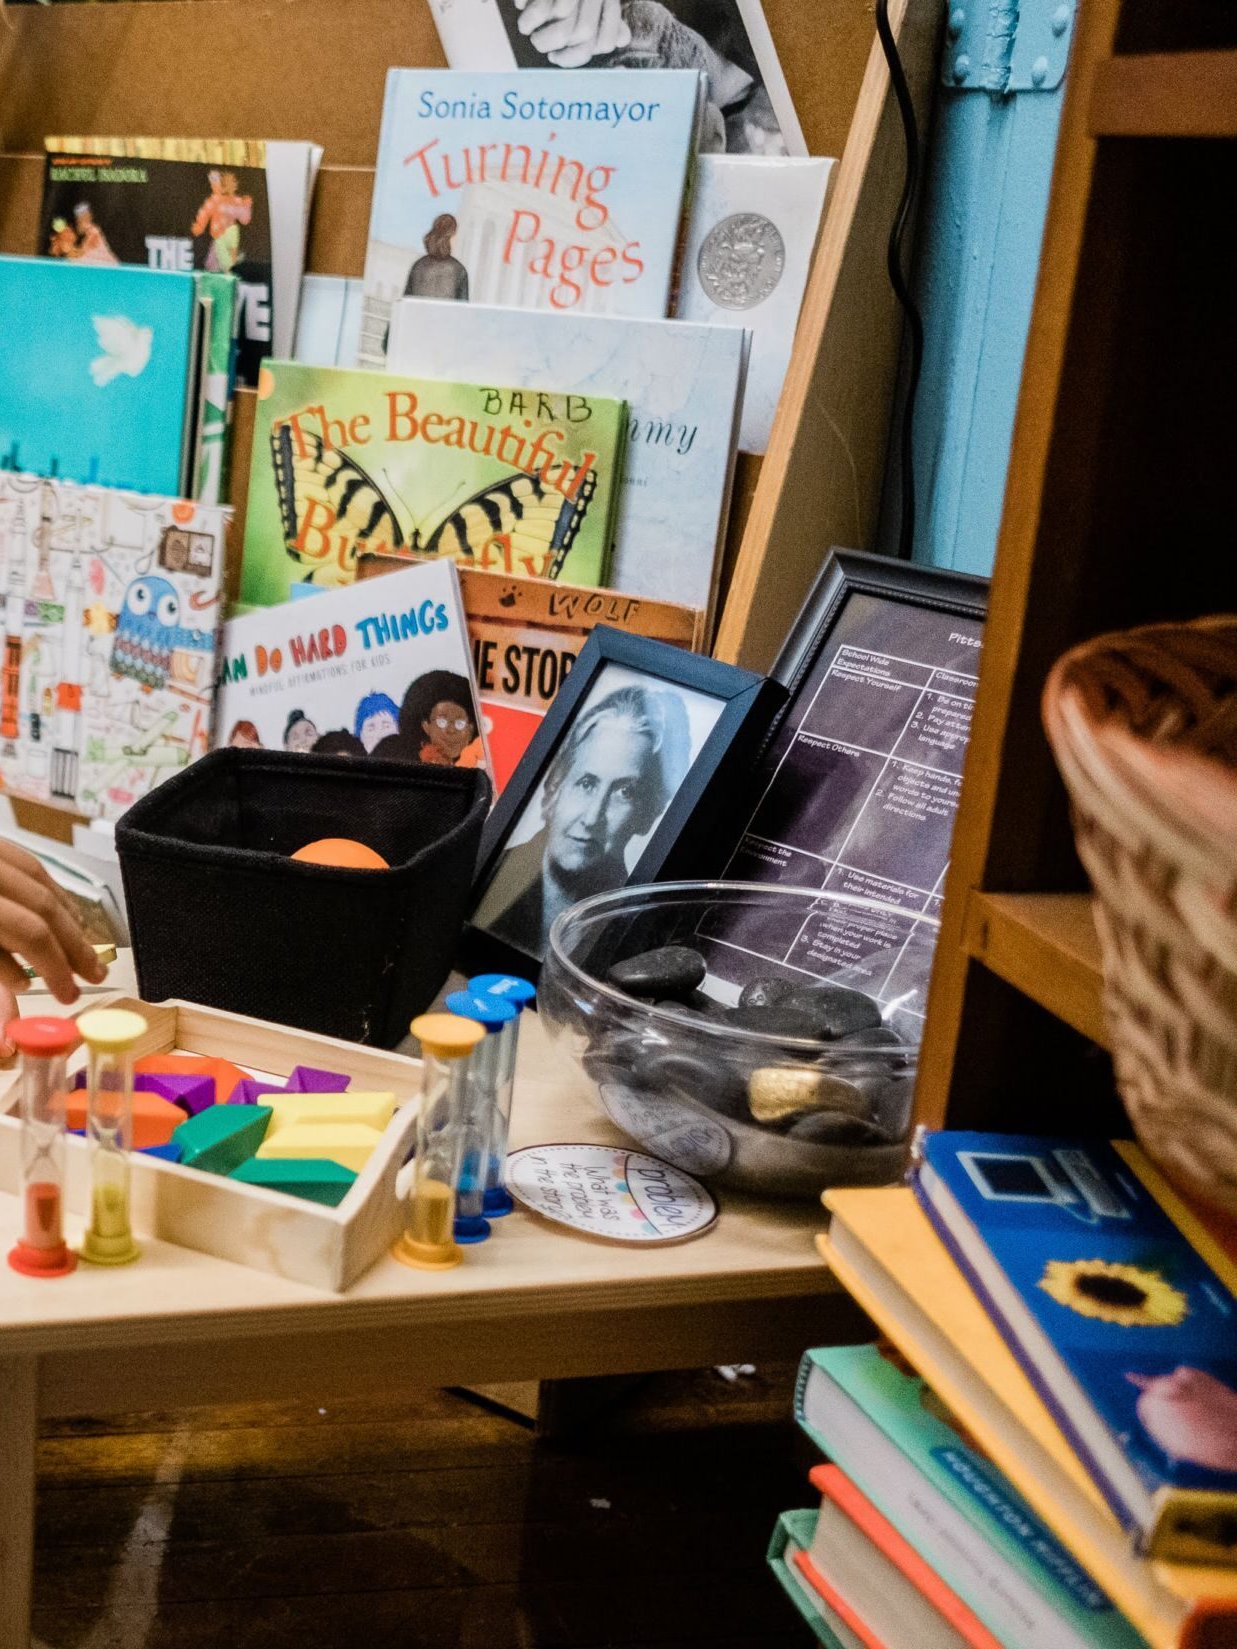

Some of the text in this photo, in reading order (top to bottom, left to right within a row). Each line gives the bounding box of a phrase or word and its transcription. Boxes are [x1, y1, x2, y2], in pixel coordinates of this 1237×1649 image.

[418, 91, 660, 128] Sonia Sotomayor
[403, 132, 618, 231] Turning
[145, 235, 194, 270] THE
[502, 209, 644, 309] Pages
[480, 388, 593, 423] BARB
[274, 391, 597, 500] The Beautiful
[220, 599, 449, 686] AN DO HARD THINGS
[948, 632, 984, 648] Pitts
[837, 658, 891, 677] Expectations
[842, 649, 890, 665] School Wide
[831, 669, 902, 692] Respect Yourself
[923, 724, 939, 734] Use
[798, 735, 860, 757] Respect Others
[918, 734, 956, 750] language
[897, 775, 930, 789] objects
[930, 785, 948, 794] and
[848, 871, 864, 882] Use
[865, 877, 905, 895] materials
